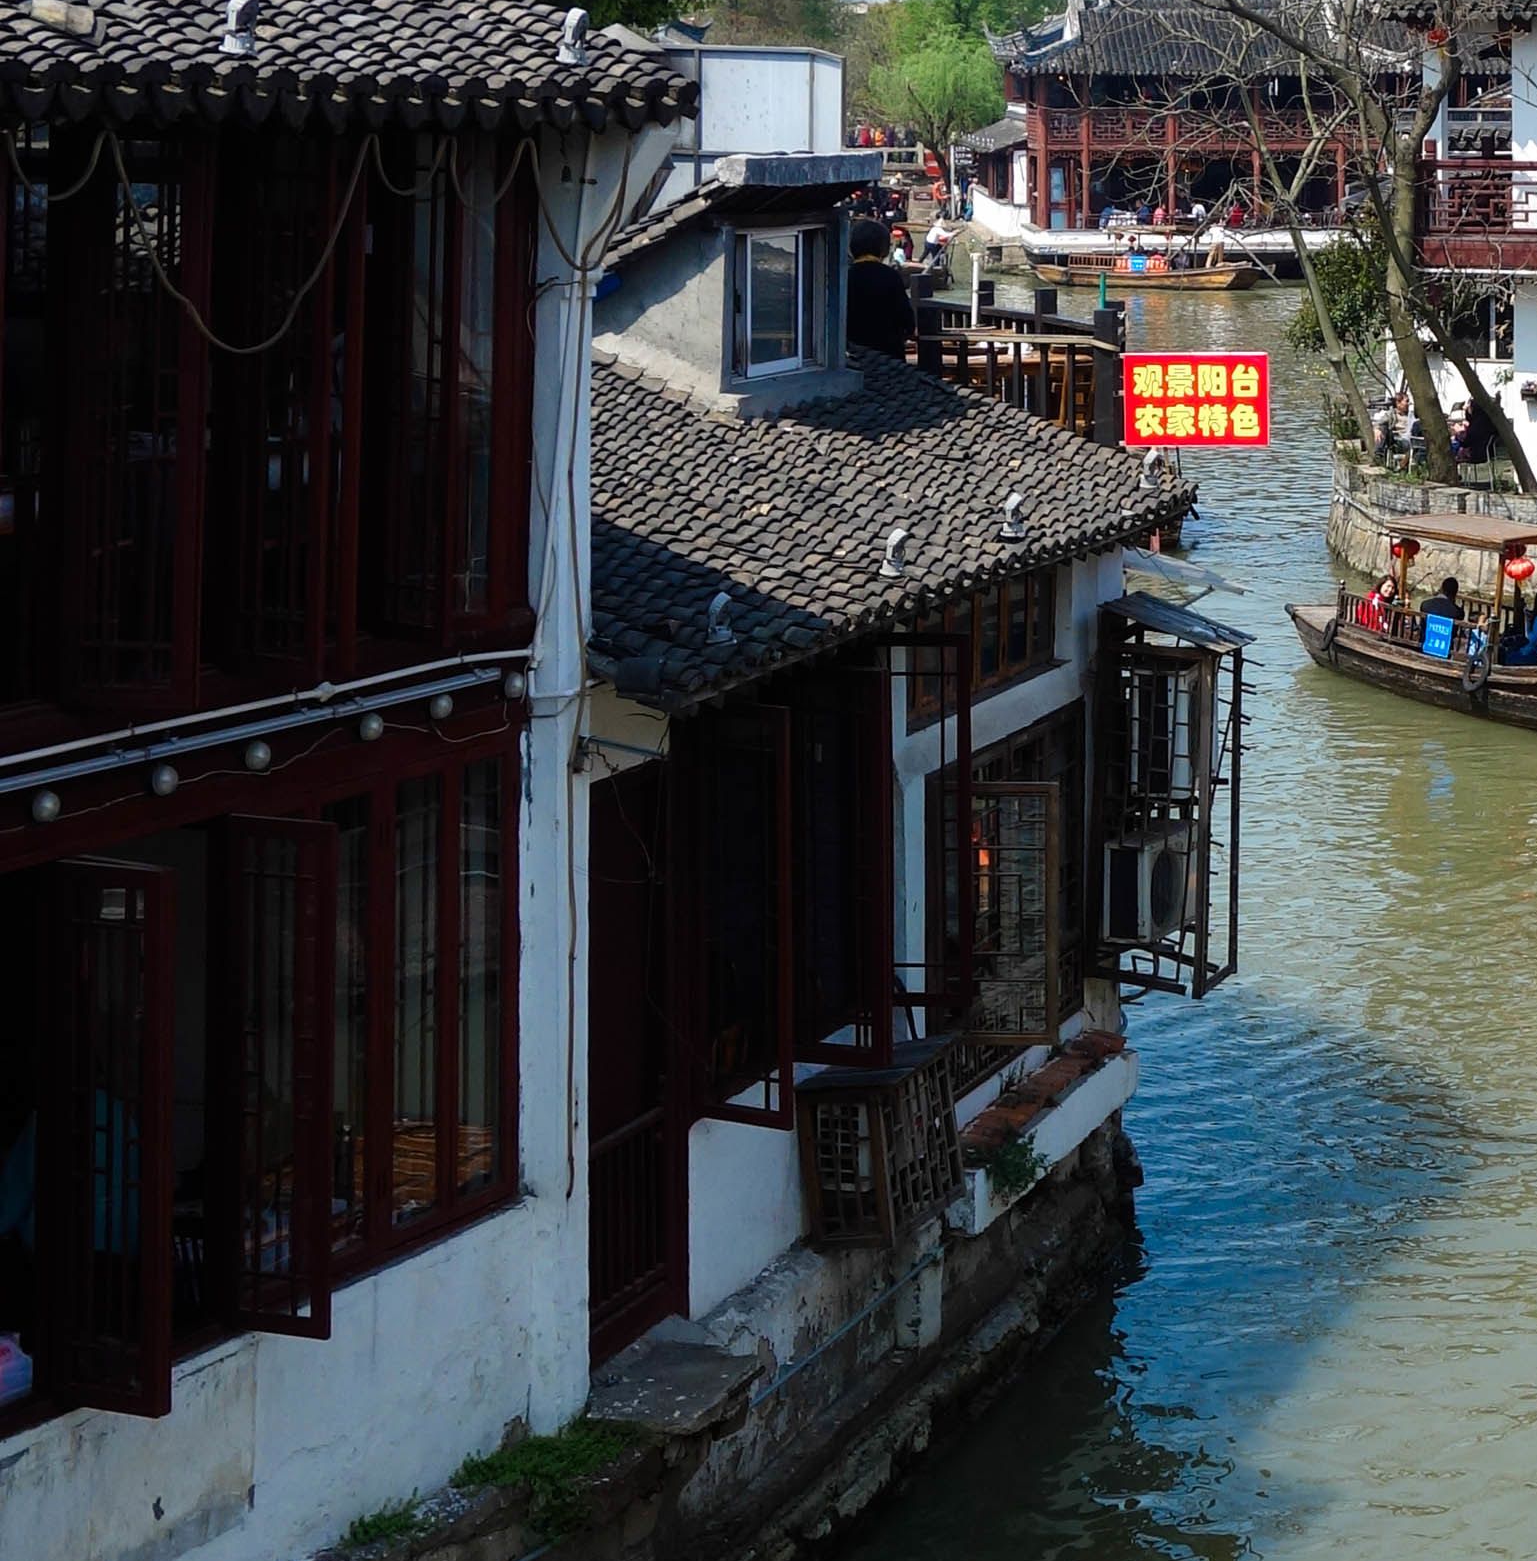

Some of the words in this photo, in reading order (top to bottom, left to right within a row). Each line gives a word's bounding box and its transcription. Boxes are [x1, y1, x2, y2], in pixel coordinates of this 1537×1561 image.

[1133, 364, 1260, 398] 观景阳台
[1135, 403, 1261, 438] 农家特色
